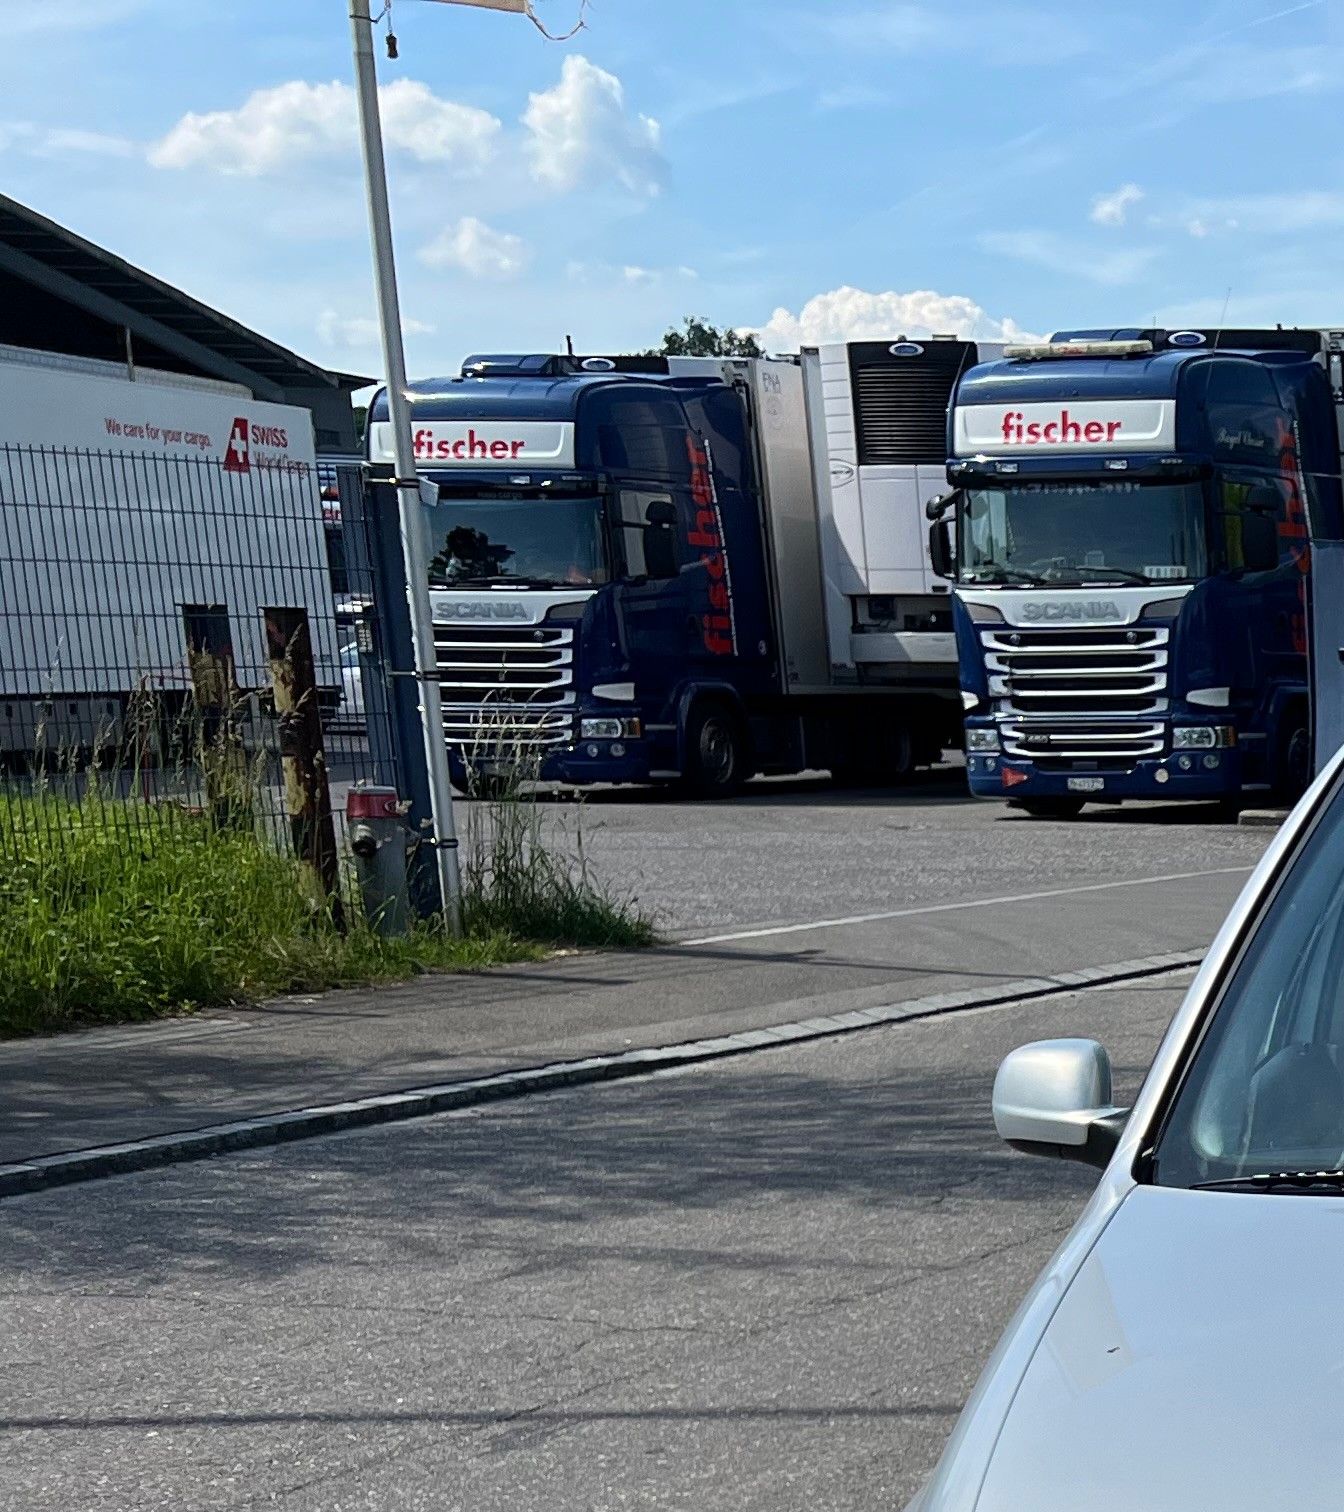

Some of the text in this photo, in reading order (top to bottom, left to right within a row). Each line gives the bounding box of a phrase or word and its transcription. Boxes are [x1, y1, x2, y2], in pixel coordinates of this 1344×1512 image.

[104, 417, 121, 436] We
[123, 422, 144, 439] care
[145, 422, 160, 441] for
[161, 429, 182, 446] your
[252, 424, 289, 449] SWISS
[1002, 410, 1122, 444] fischer
[413, 429, 525, 460] fischer
[686, 435, 733, 656] fischer
[435, 601, 529, 620] SCANIA
[1022, 601, 1121, 621] SCANIA
